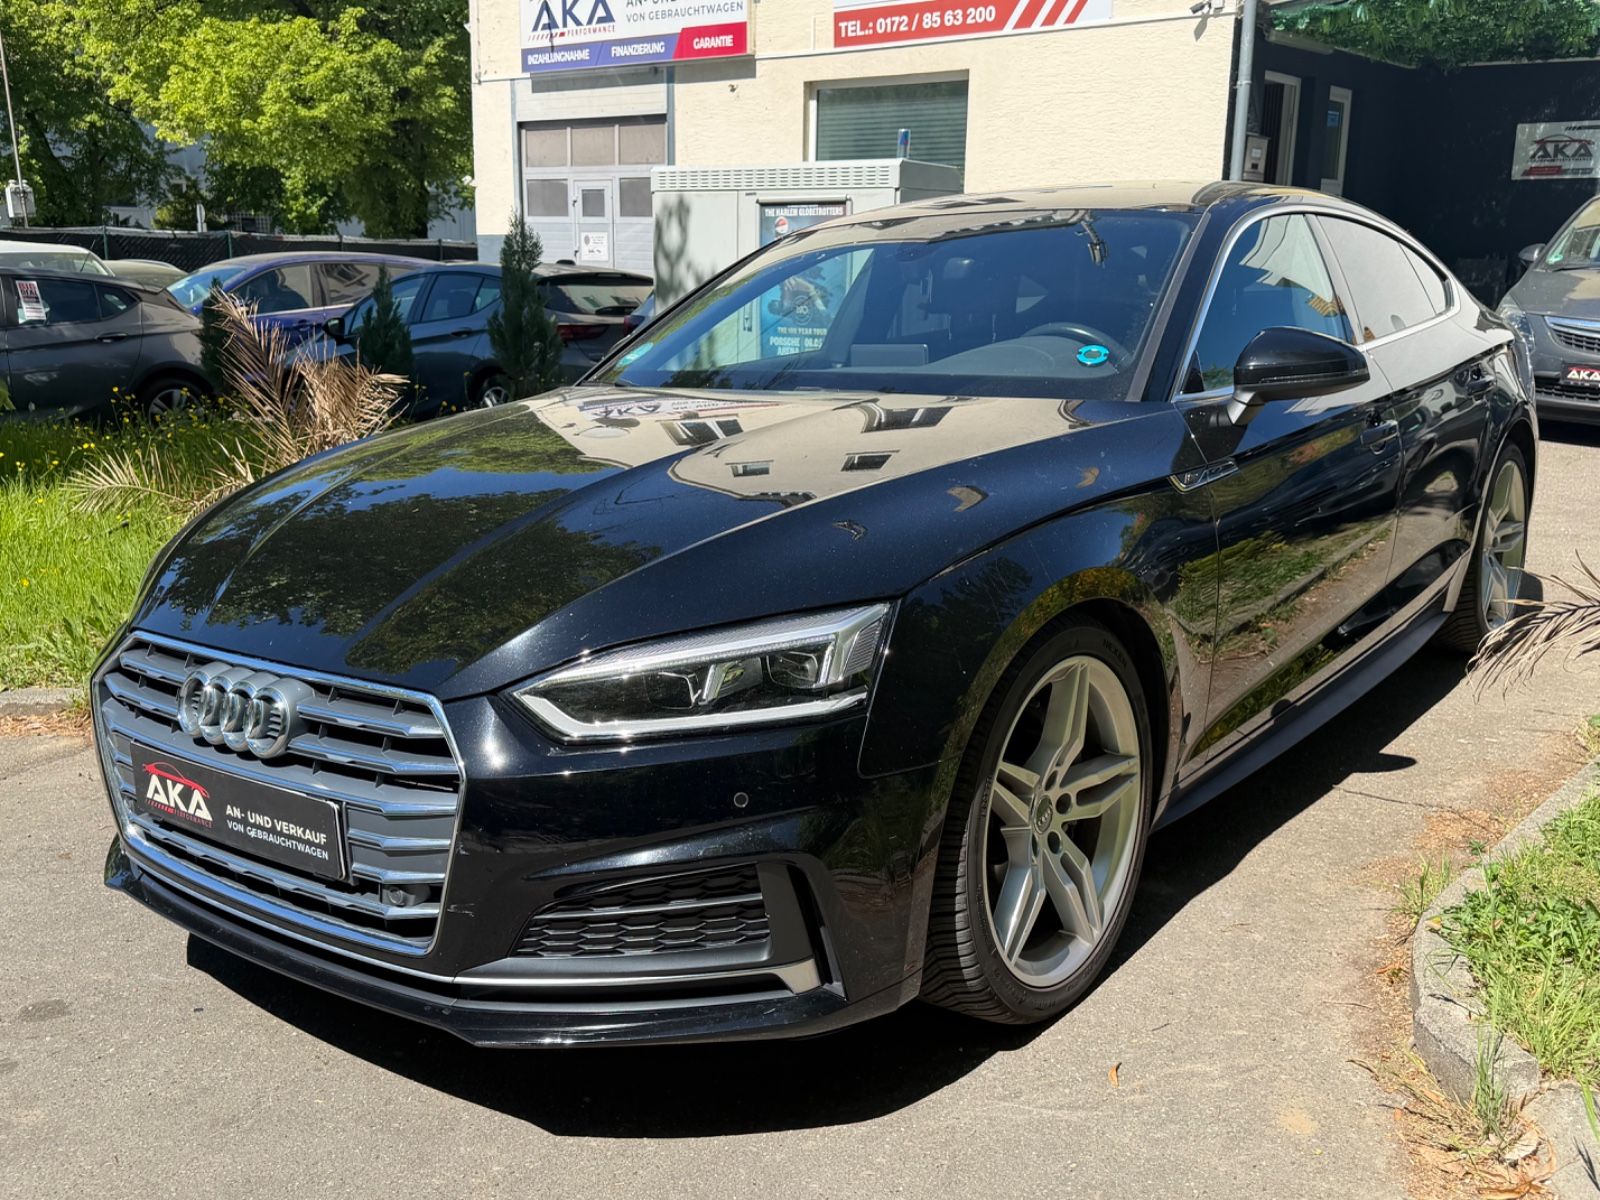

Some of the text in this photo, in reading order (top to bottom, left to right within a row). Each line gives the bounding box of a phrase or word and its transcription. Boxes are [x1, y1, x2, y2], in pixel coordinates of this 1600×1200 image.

[532, 0, 616, 32] AKA
[626, 2, 744, 23] VON GEBRAUCHTWAGEN
[838, 5, 996, 38] TEL.: 0172 / 85 63 200
[567, 25, 616, 37] PERFORMANCE
[693, 35, 734, 49] GARANTIE
[527, 41, 665, 66] INZAHLUNGNAHME FINANZIERUNG
[1529, 143, 1593, 159] AKA
[1567, 368, 1600, 381] AKA
[146, 774, 213, 822] AKA
[226, 804, 327, 845] AN- UND VERKAUF
[226, 820, 329, 861] VON GEBRAUCHTWAGEN
